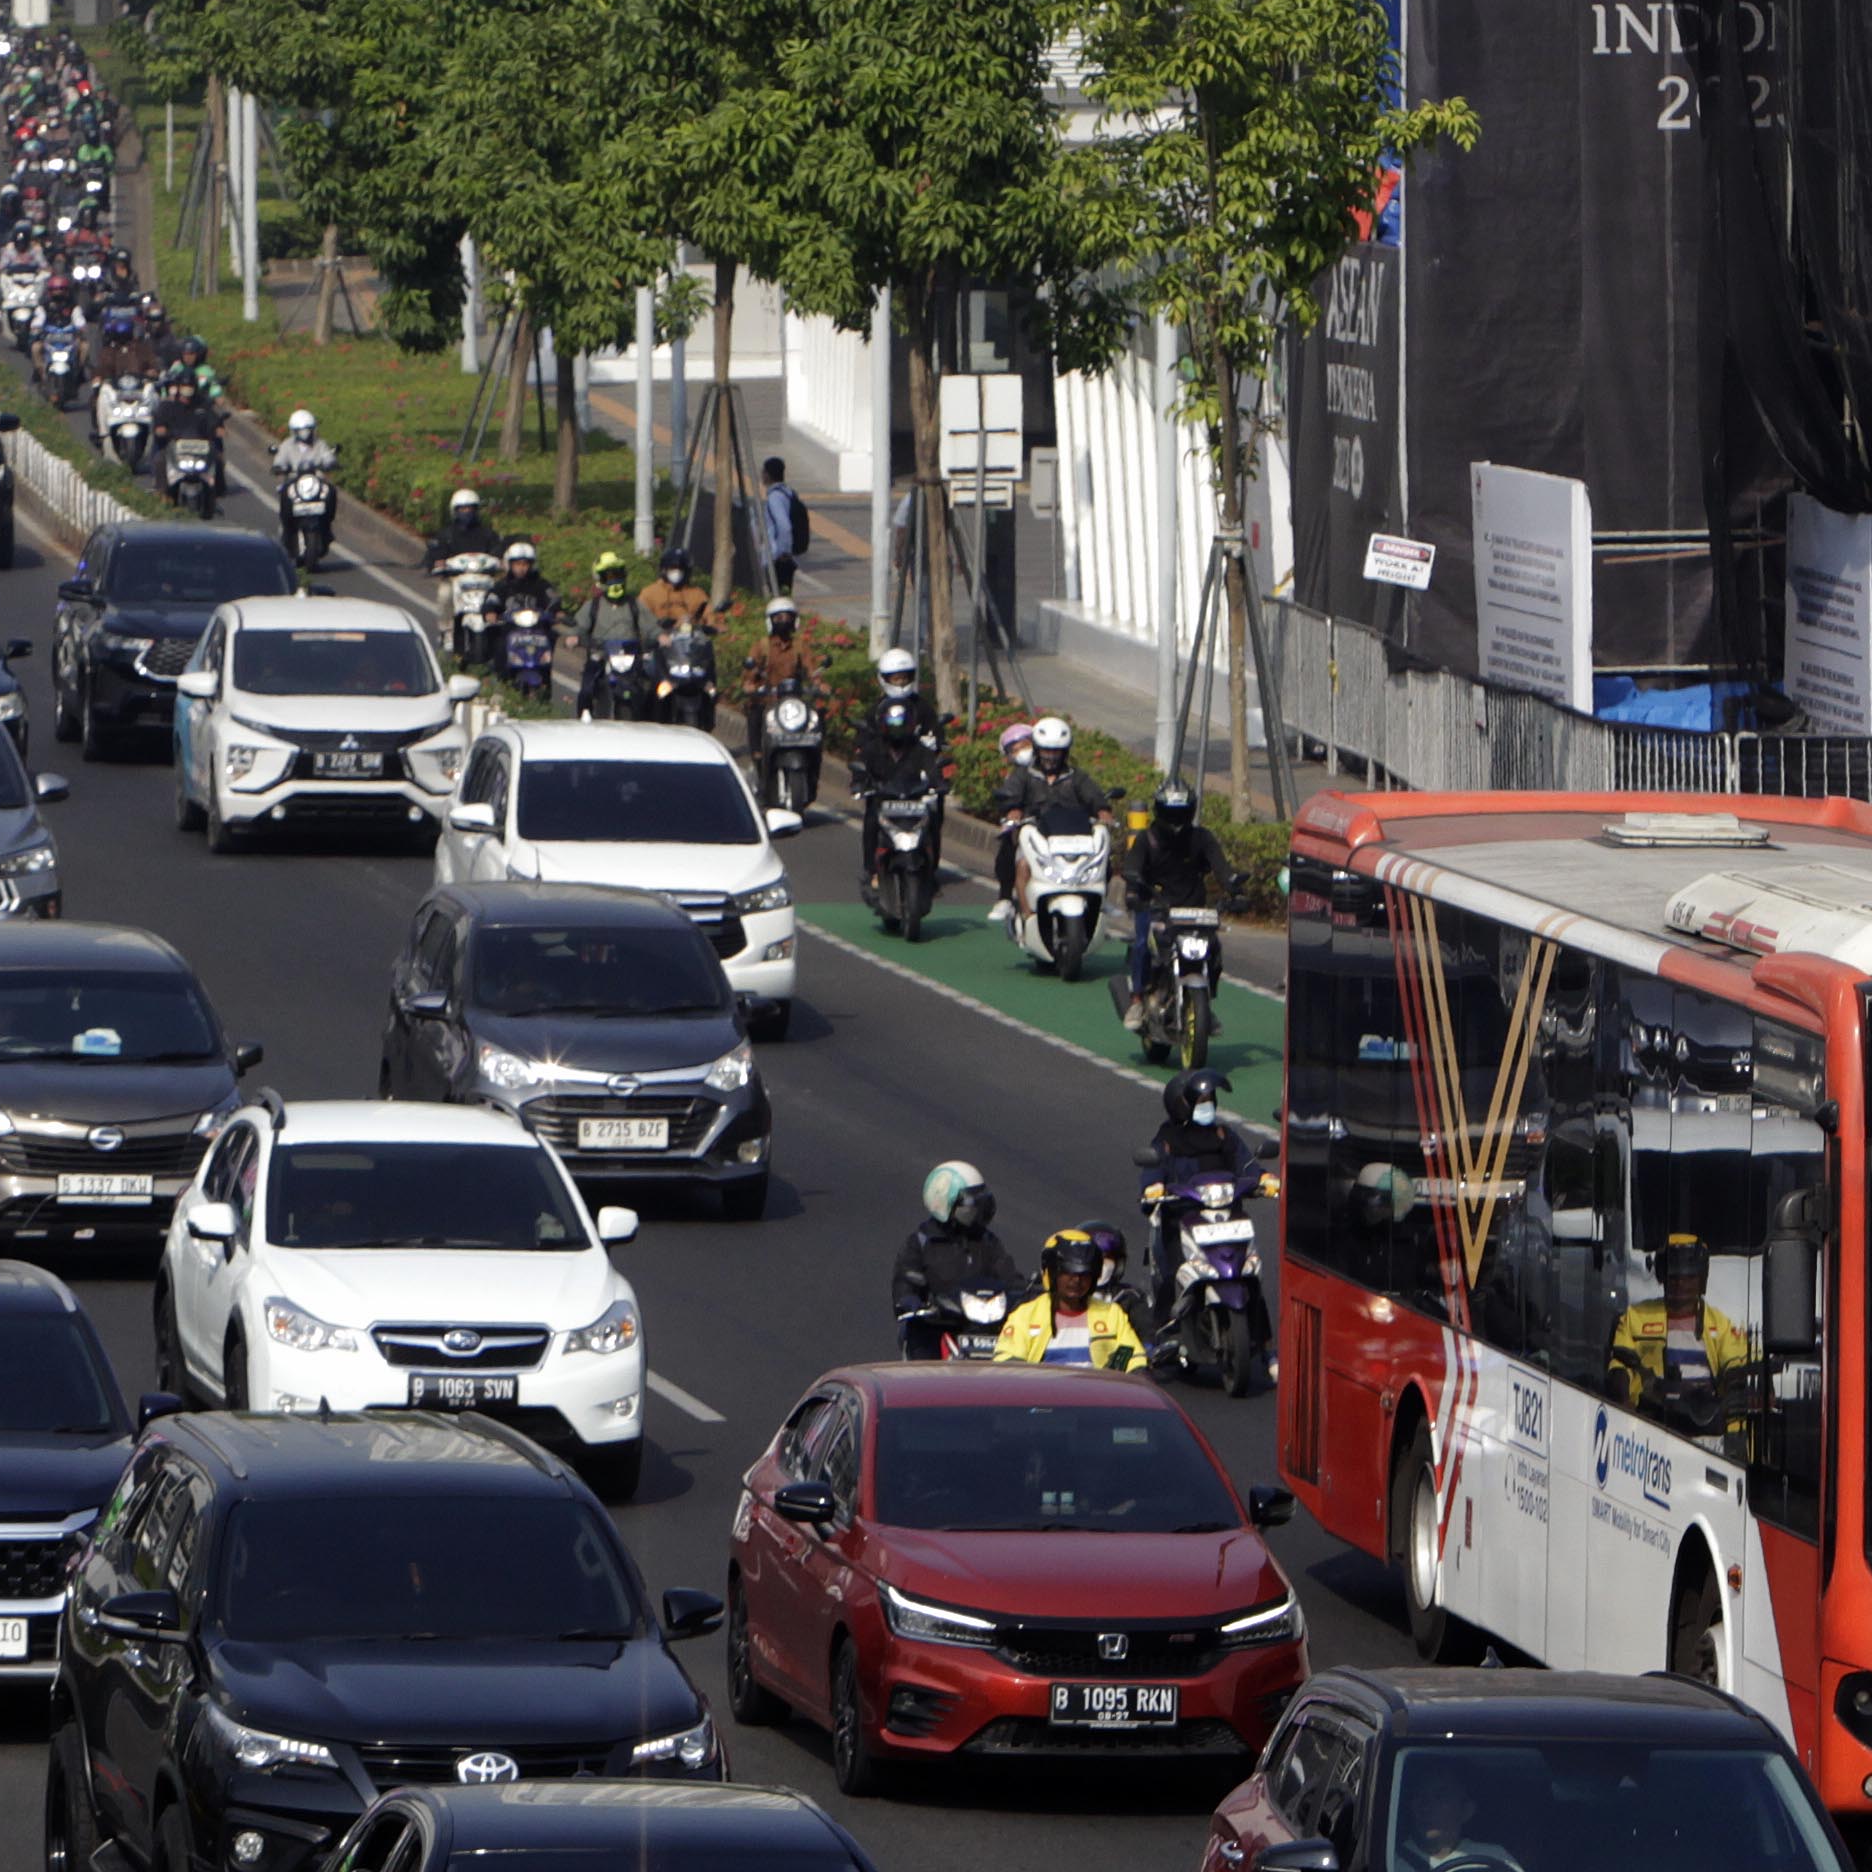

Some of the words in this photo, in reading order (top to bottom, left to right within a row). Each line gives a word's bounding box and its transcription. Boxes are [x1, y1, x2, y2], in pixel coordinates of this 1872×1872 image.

[583, 1122, 592, 1137] B
[413, 1377, 425, 1398] B
[438, 1377, 475, 1399] 1063
[484, 1378, 514, 1399] SVN
[1513, 1382, 1543, 1443] TJ821
[1612, 1431, 1672, 1498] metrotrans
[1055, 1687, 1069, 1710] B
[1083, 1687, 1128, 1711] 1095
[1136, 1688, 1173, 1713] RKN
